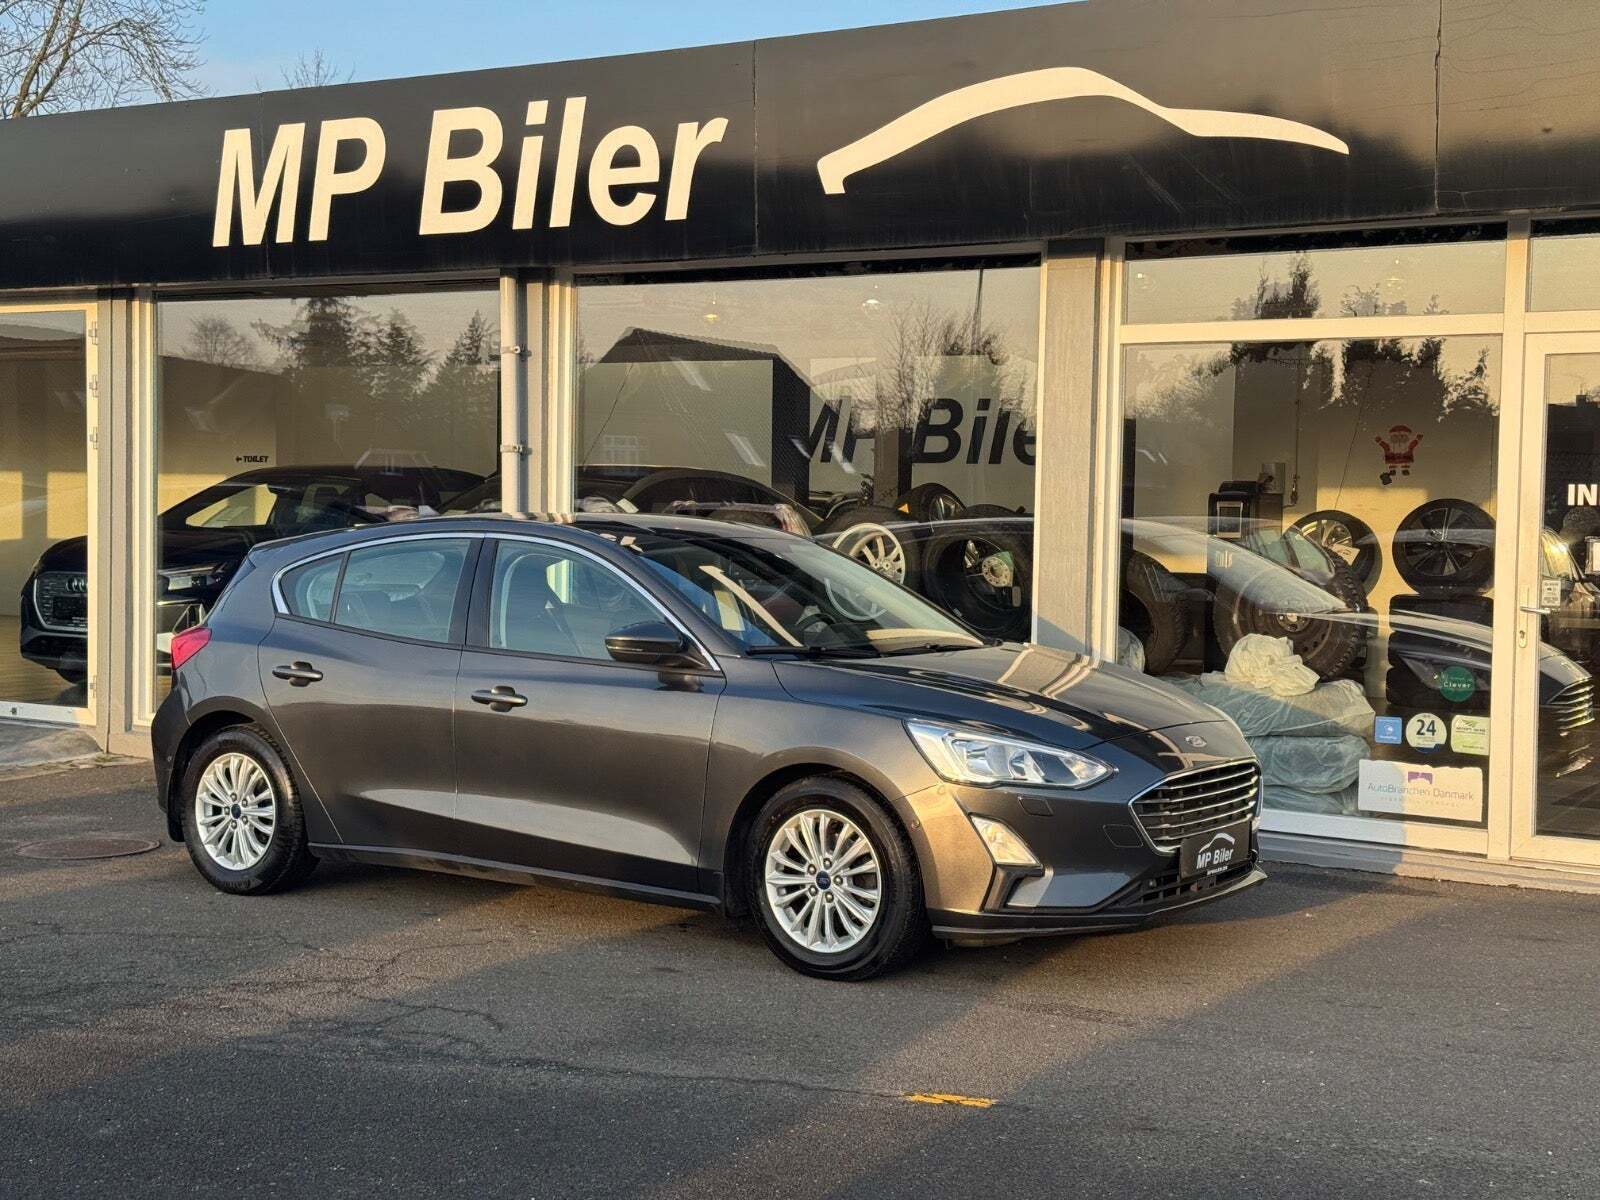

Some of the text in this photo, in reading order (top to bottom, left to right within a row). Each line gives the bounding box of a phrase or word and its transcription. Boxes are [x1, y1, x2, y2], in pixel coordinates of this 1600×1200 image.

[212, 96, 729, 247] MP Biler
[243, 455, 269, 463] TOILET
[1567, 483, 1600, 507] IN
[1443, 681, 1471, 689] Clever
[1416, 719, 1437, 736] 24
[1433, 787, 1475, 801] Danmark
[1196, 848, 1234, 869] MP Biler
